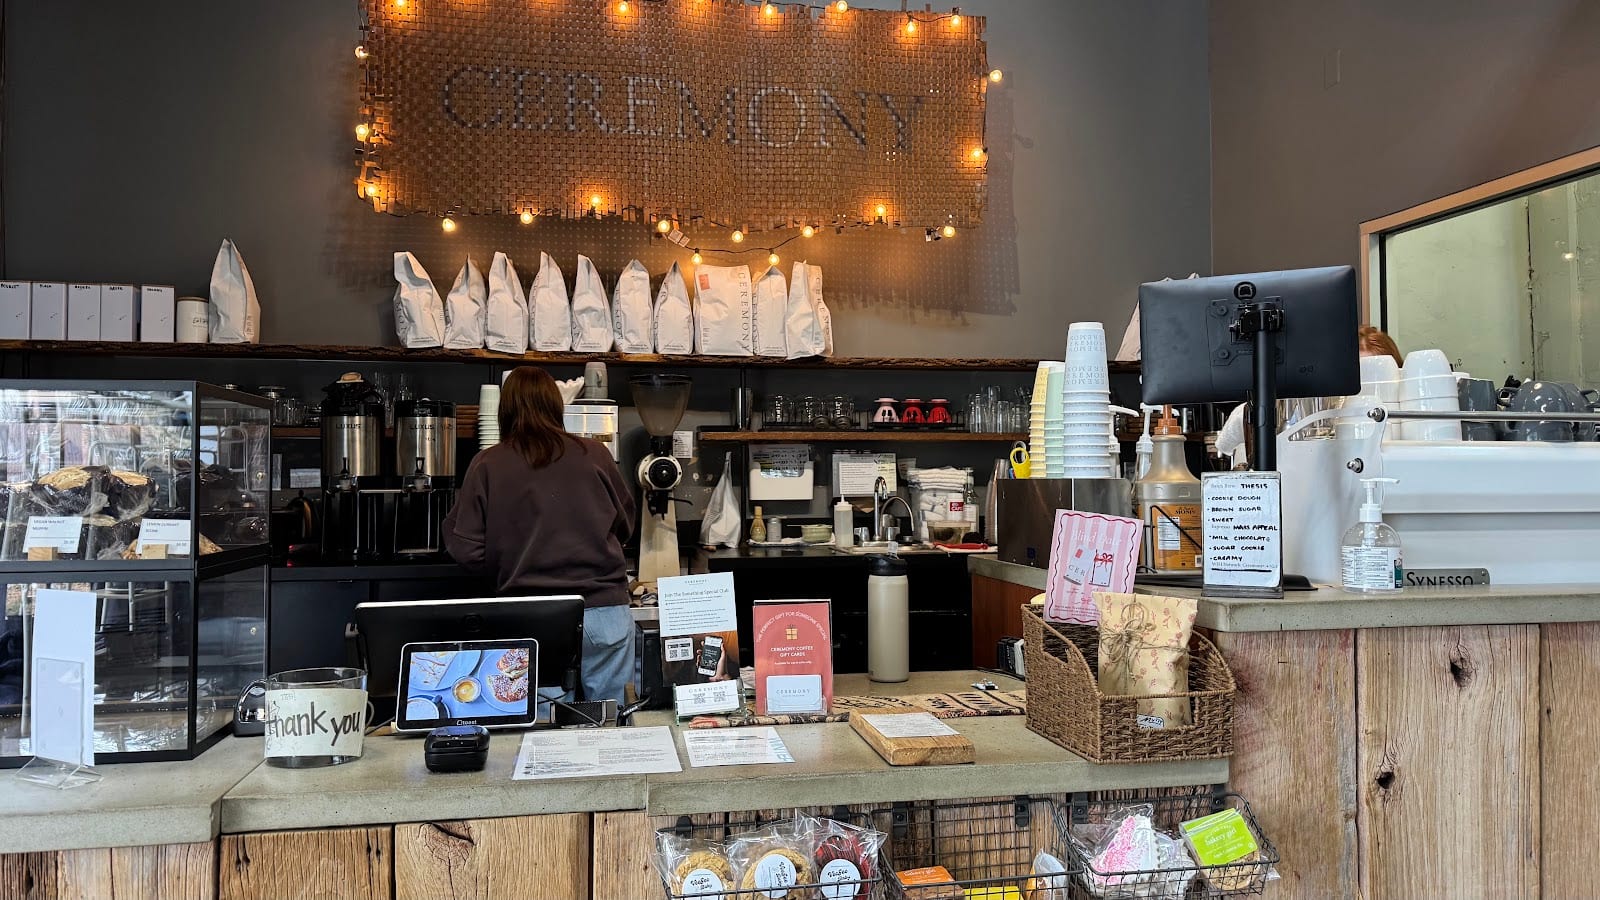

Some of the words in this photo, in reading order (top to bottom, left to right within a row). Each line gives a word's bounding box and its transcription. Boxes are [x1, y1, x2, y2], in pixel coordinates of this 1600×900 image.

[440, 65, 924, 151] CEREMONY
[738, 271, 751, 351] CEREMONY
[1068, 564, 1086, 577] CER
[688, 685, 728, 693] CEREMONY
[265, 701, 329, 738] thank
[330, 711, 361, 747] you
